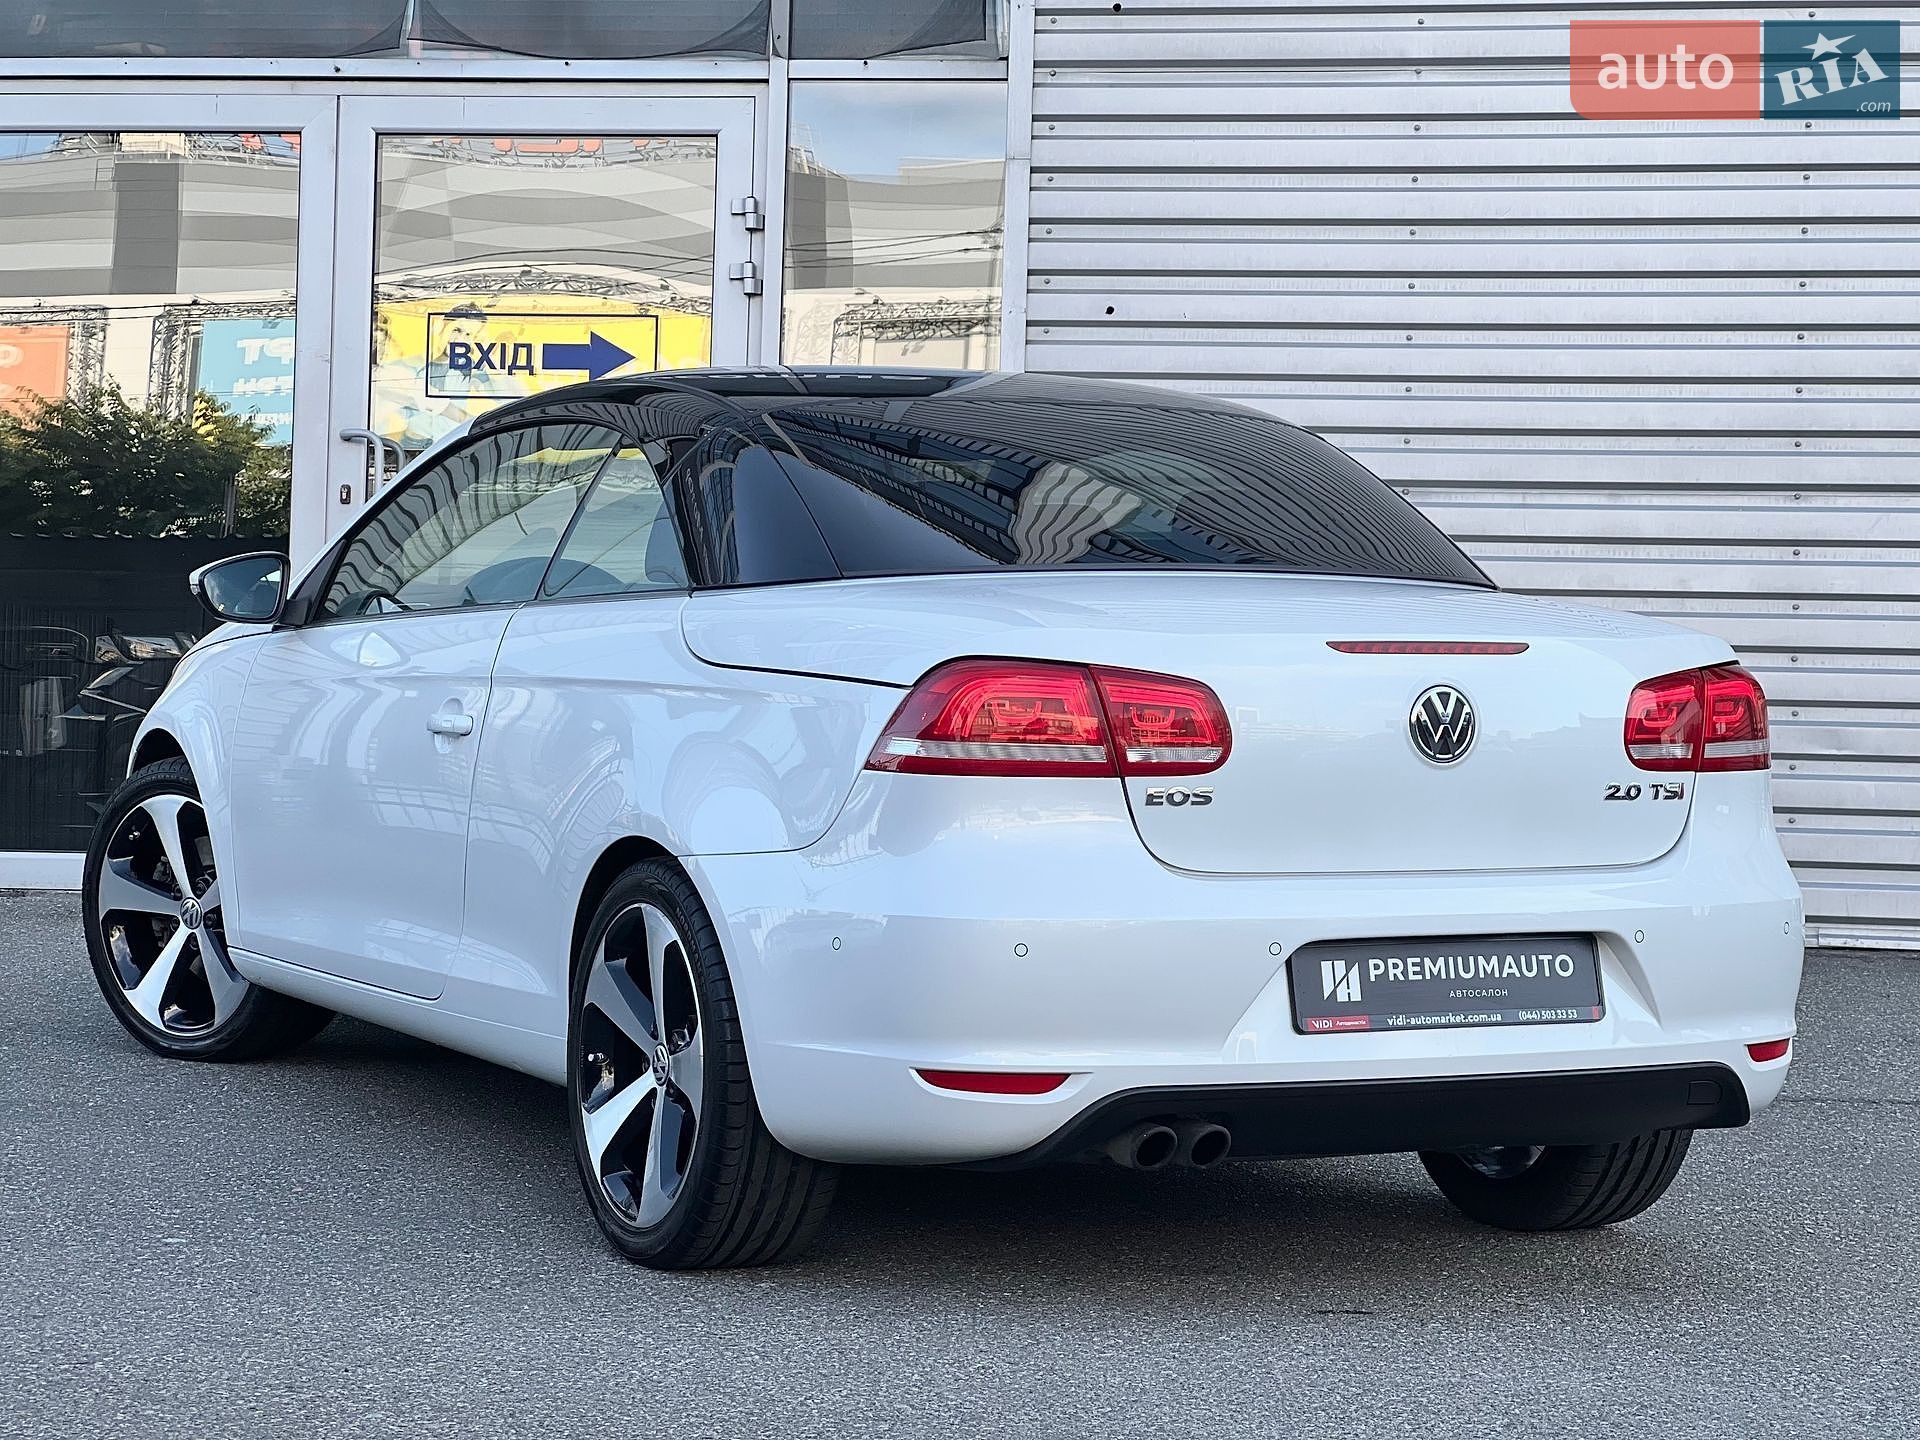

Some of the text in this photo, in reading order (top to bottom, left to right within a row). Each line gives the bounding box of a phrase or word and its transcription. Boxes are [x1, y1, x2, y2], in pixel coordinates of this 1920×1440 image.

[449, 342, 534, 375] ВХІД
[1145, 786, 1214, 807] EOS
[1649, 782, 1685, 801] TSI
[1368, 954, 1575, 982] PREMIUMAUTO
[1449, 988, 1508, 998] АВТОСАЛОН
[1387, 1012, 1502, 1026] vidi-automarket.com.ua
[1518, 1009, 1578, 1021] (044) 503 33 53
[1311, 1020, 1333, 1029] VIDI
